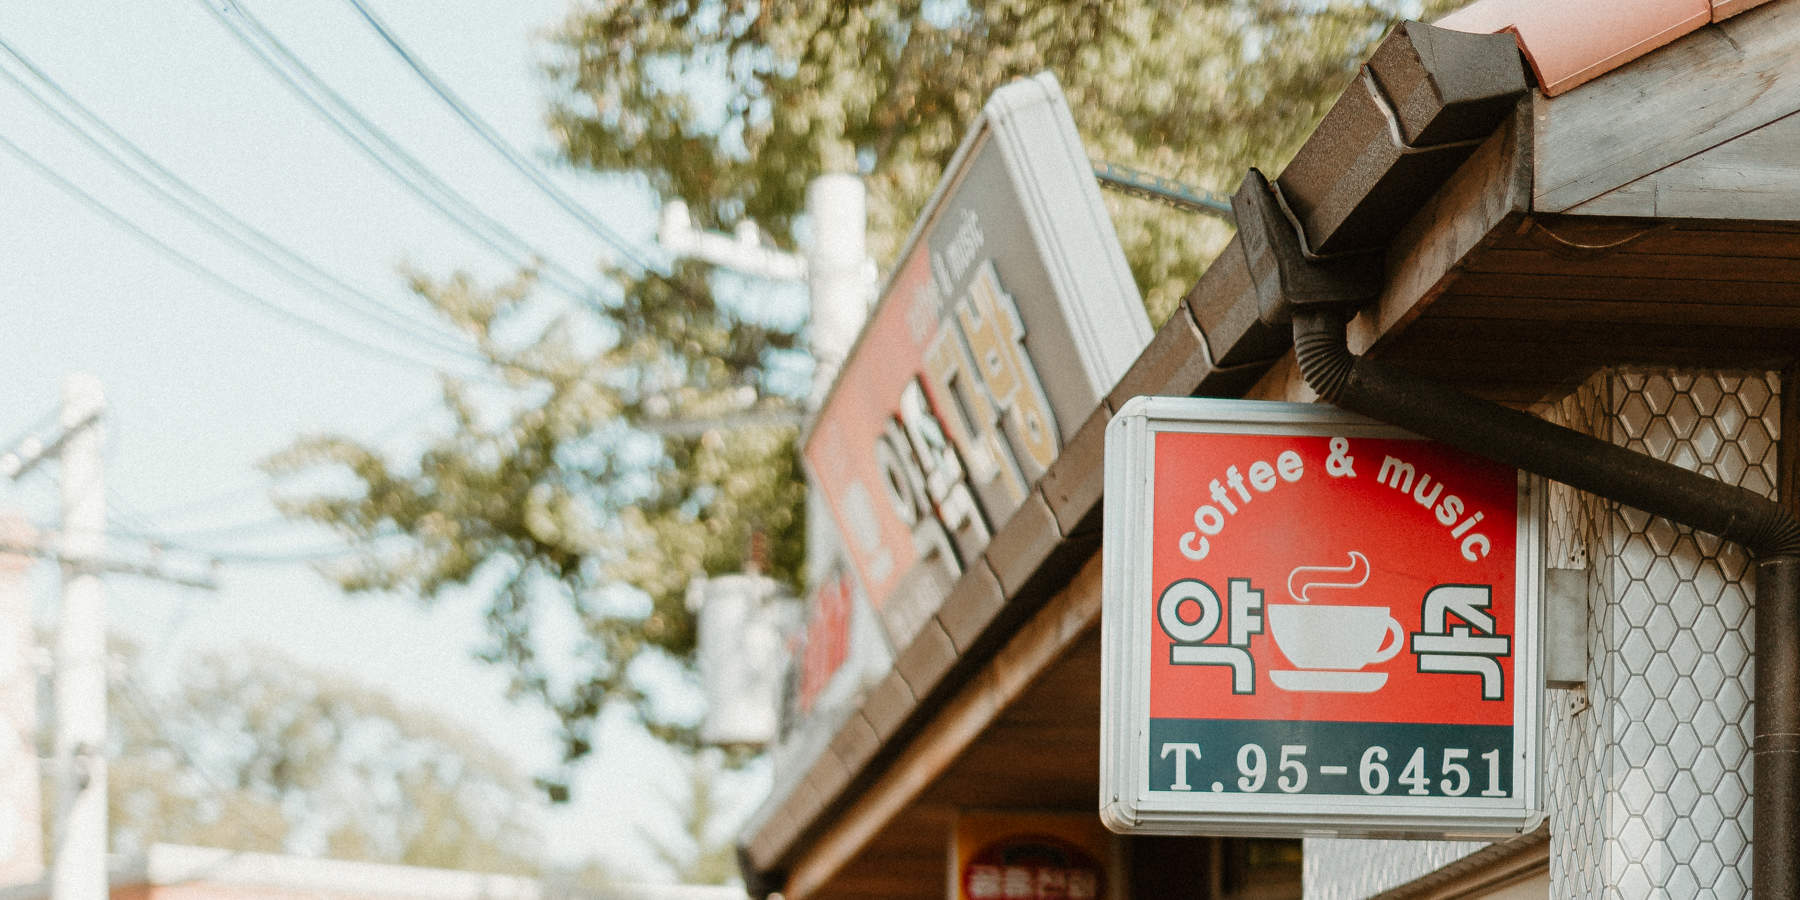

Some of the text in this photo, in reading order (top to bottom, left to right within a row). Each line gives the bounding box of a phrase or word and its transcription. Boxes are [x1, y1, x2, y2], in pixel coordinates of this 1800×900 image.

[1179, 437, 1491, 562] coffee & music
[1161, 743, 1507, 797] T.95-6451
